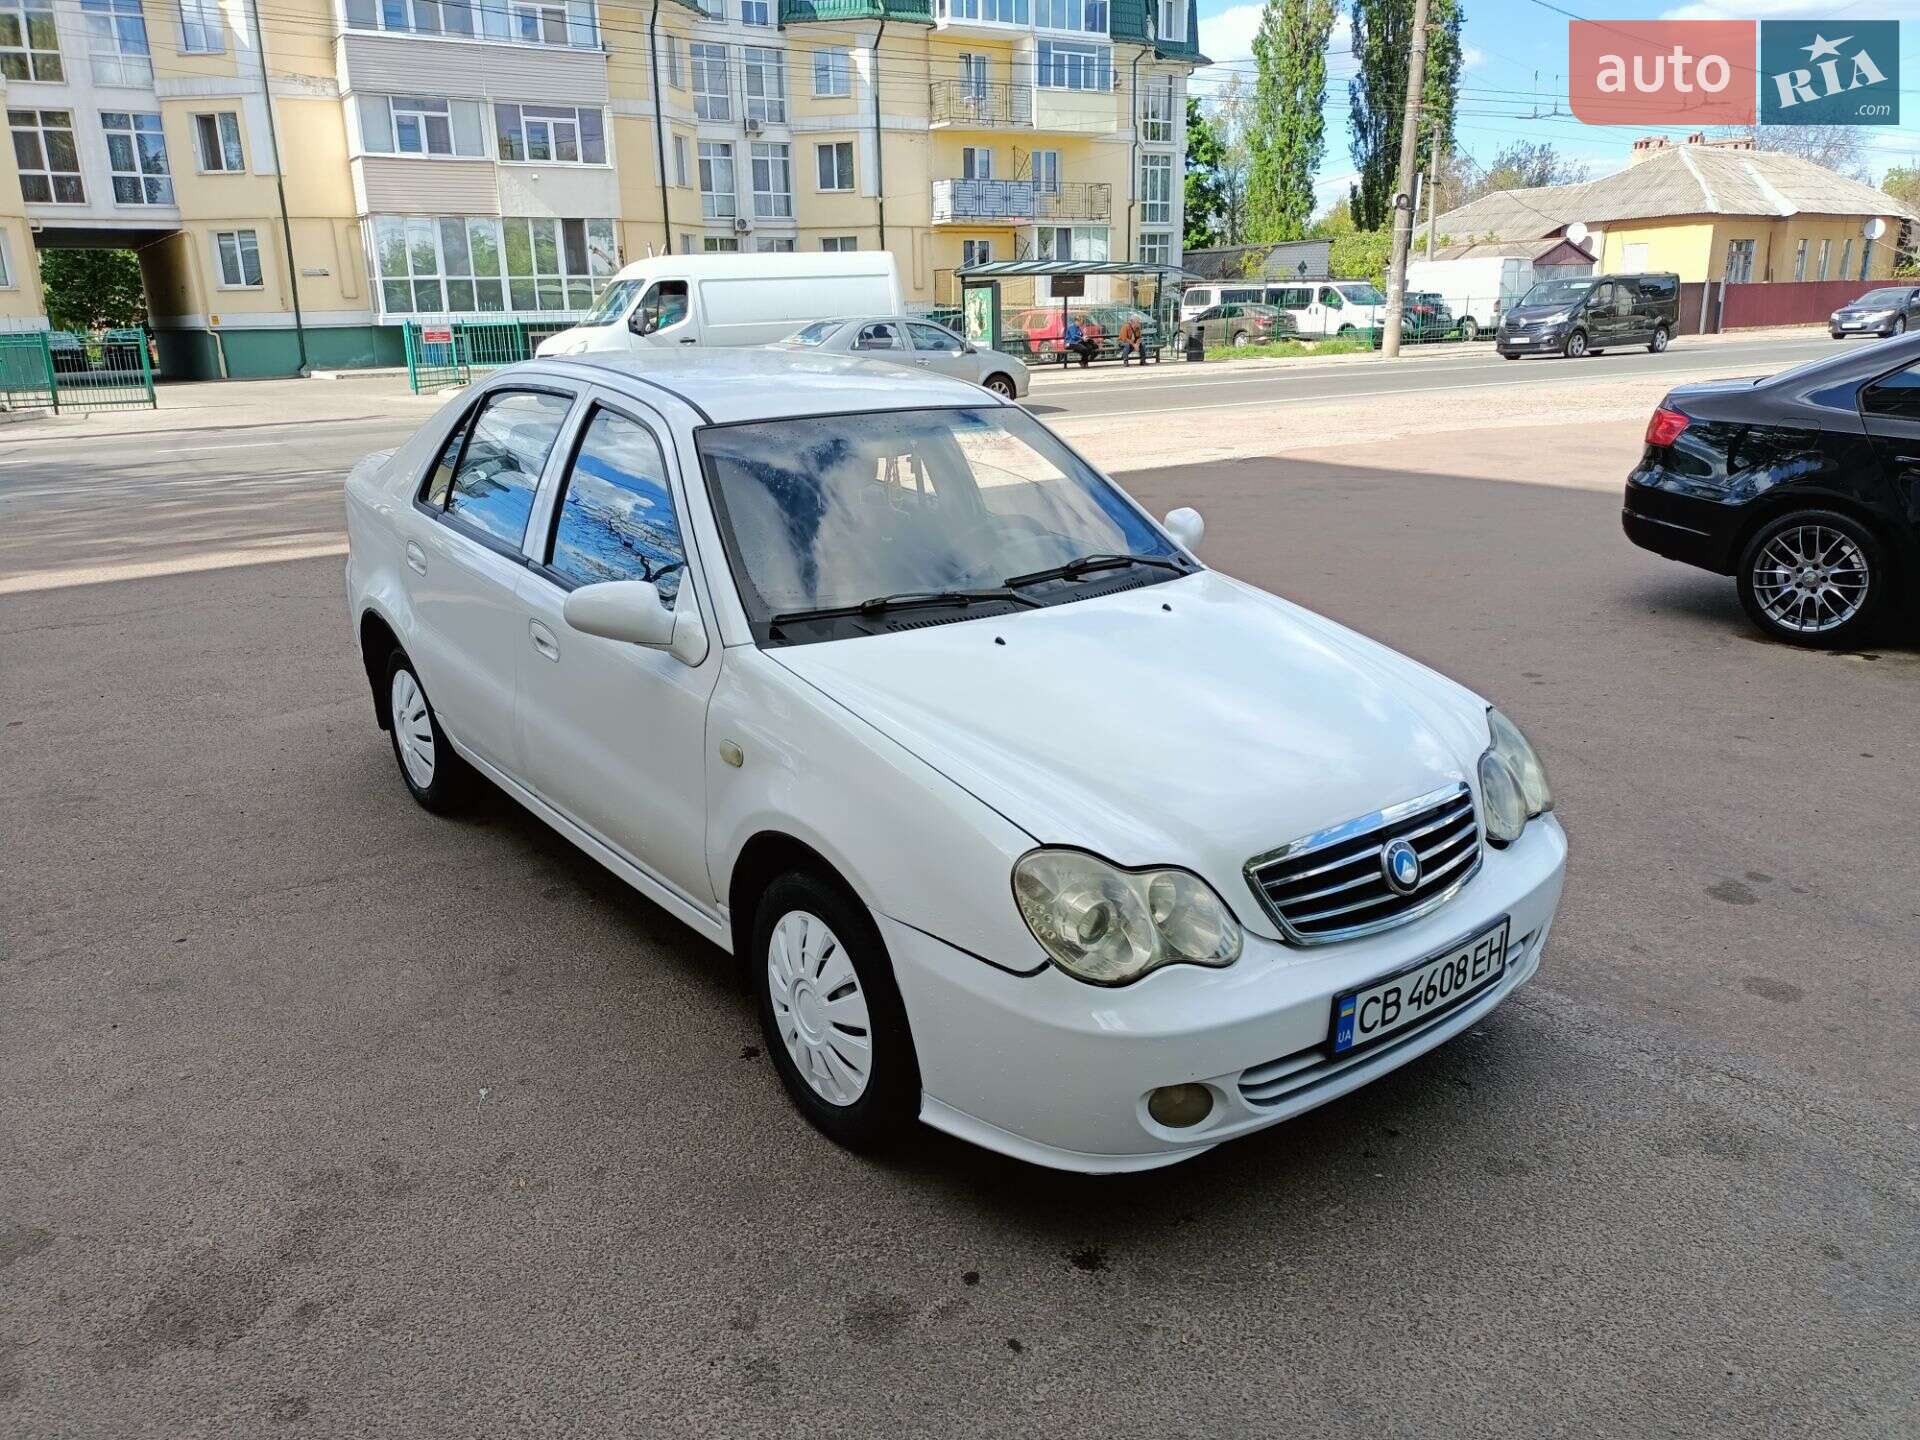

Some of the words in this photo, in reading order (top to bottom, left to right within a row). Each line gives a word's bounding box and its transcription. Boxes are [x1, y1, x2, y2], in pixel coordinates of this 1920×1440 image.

[1358, 986, 1402, 1034] CB
[1407, 954, 1469, 1011] 4608
[1471, 931, 1504, 983] EH
[1338, 1029, 1352, 1043] UA
